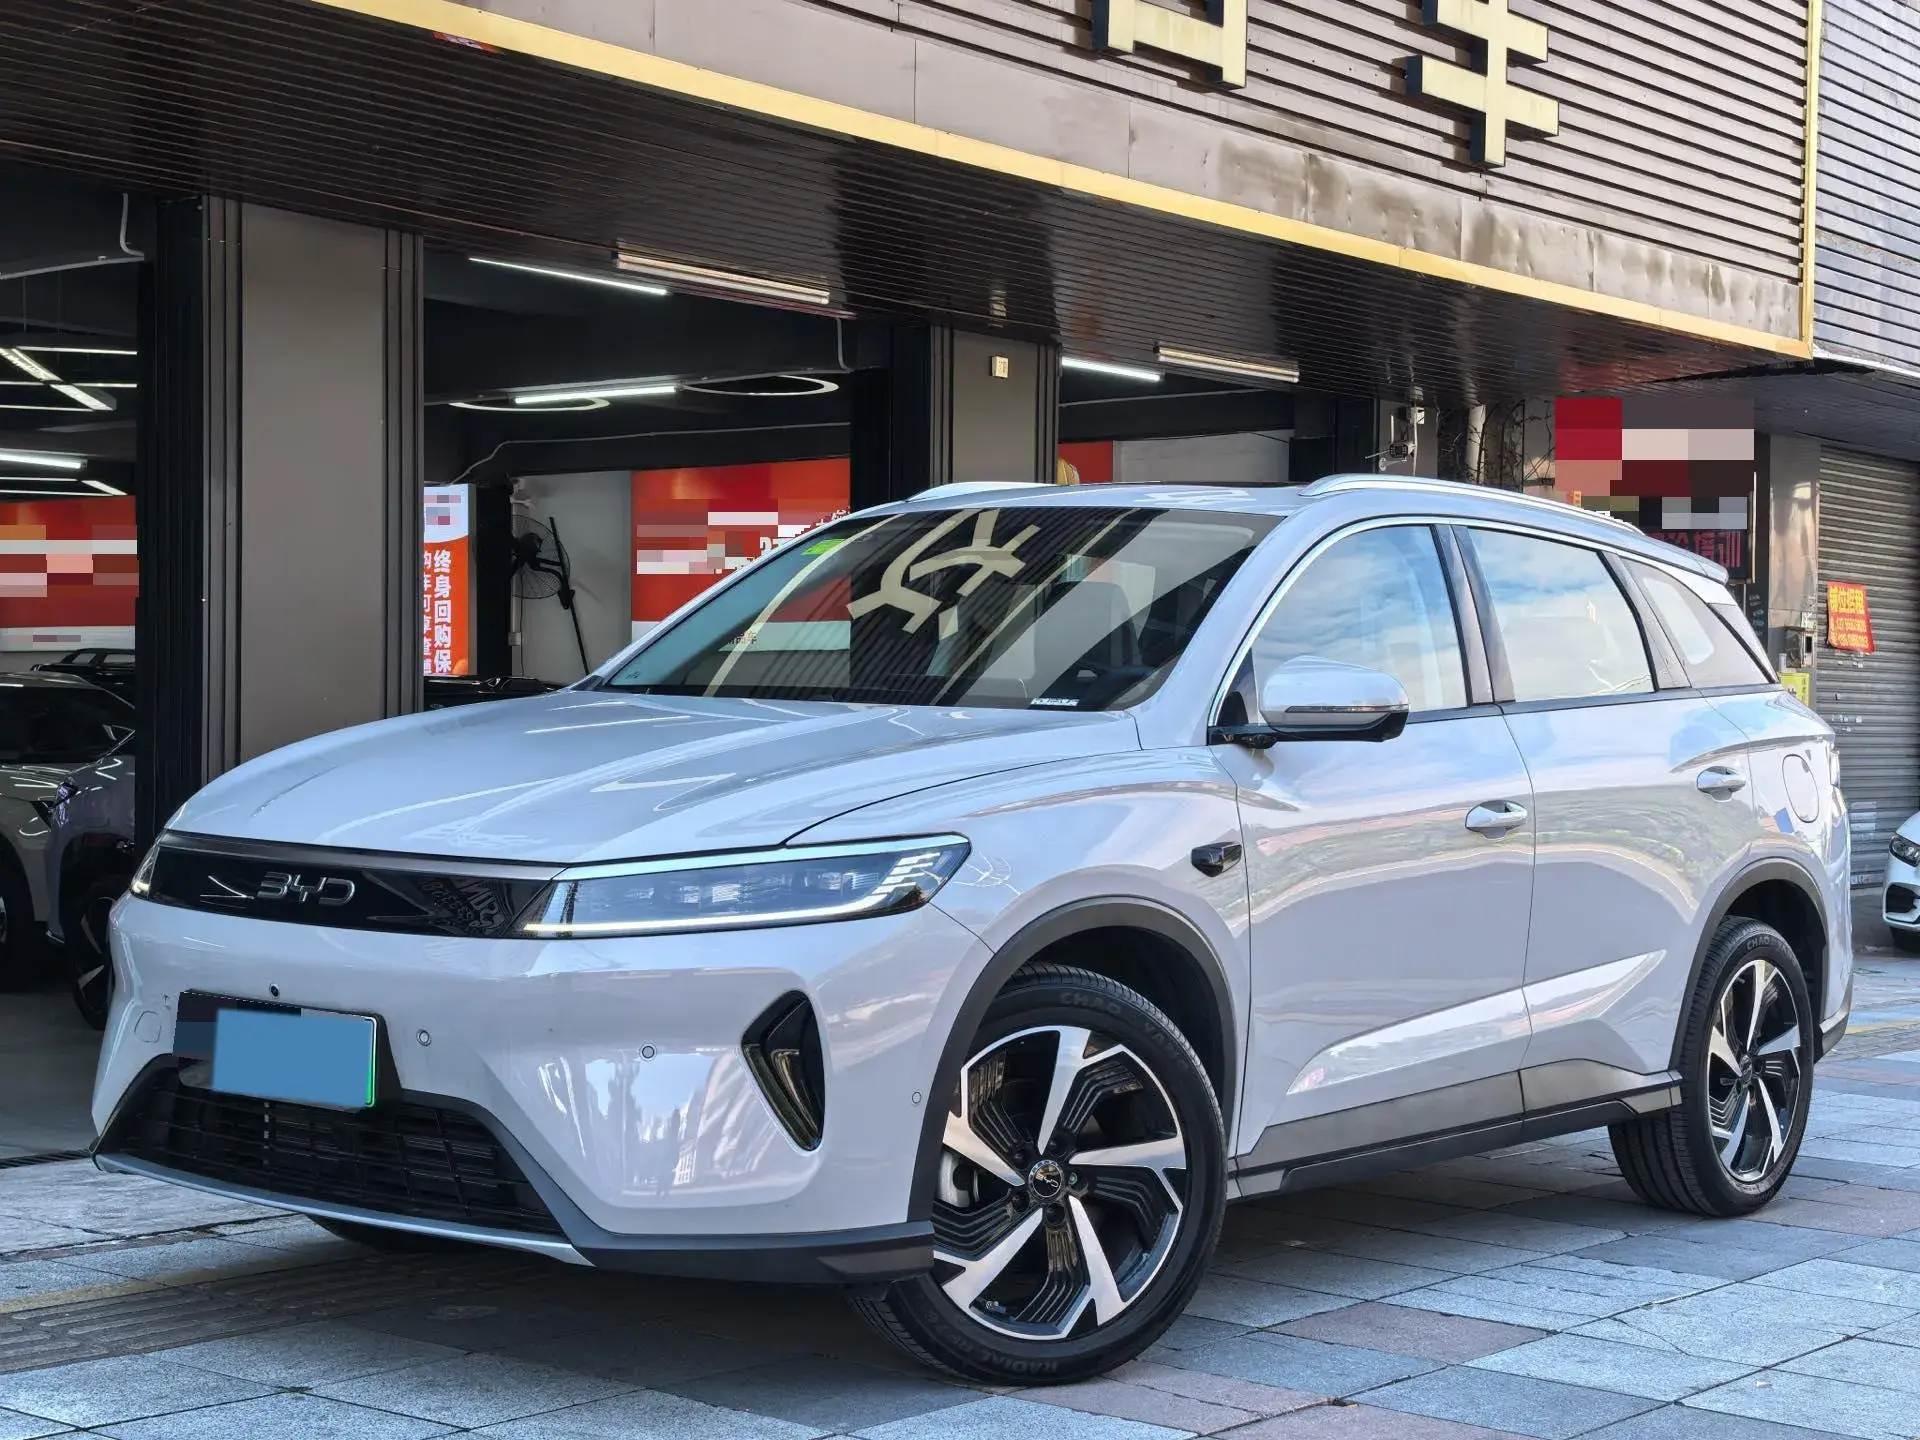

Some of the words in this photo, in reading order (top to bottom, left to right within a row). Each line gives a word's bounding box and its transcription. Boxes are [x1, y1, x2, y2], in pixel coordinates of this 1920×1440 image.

[433, 550, 452, 673] 终身回购保
[256, 871, 356, 906] BYD
[1059, 991, 1122, 1015] CHAO
